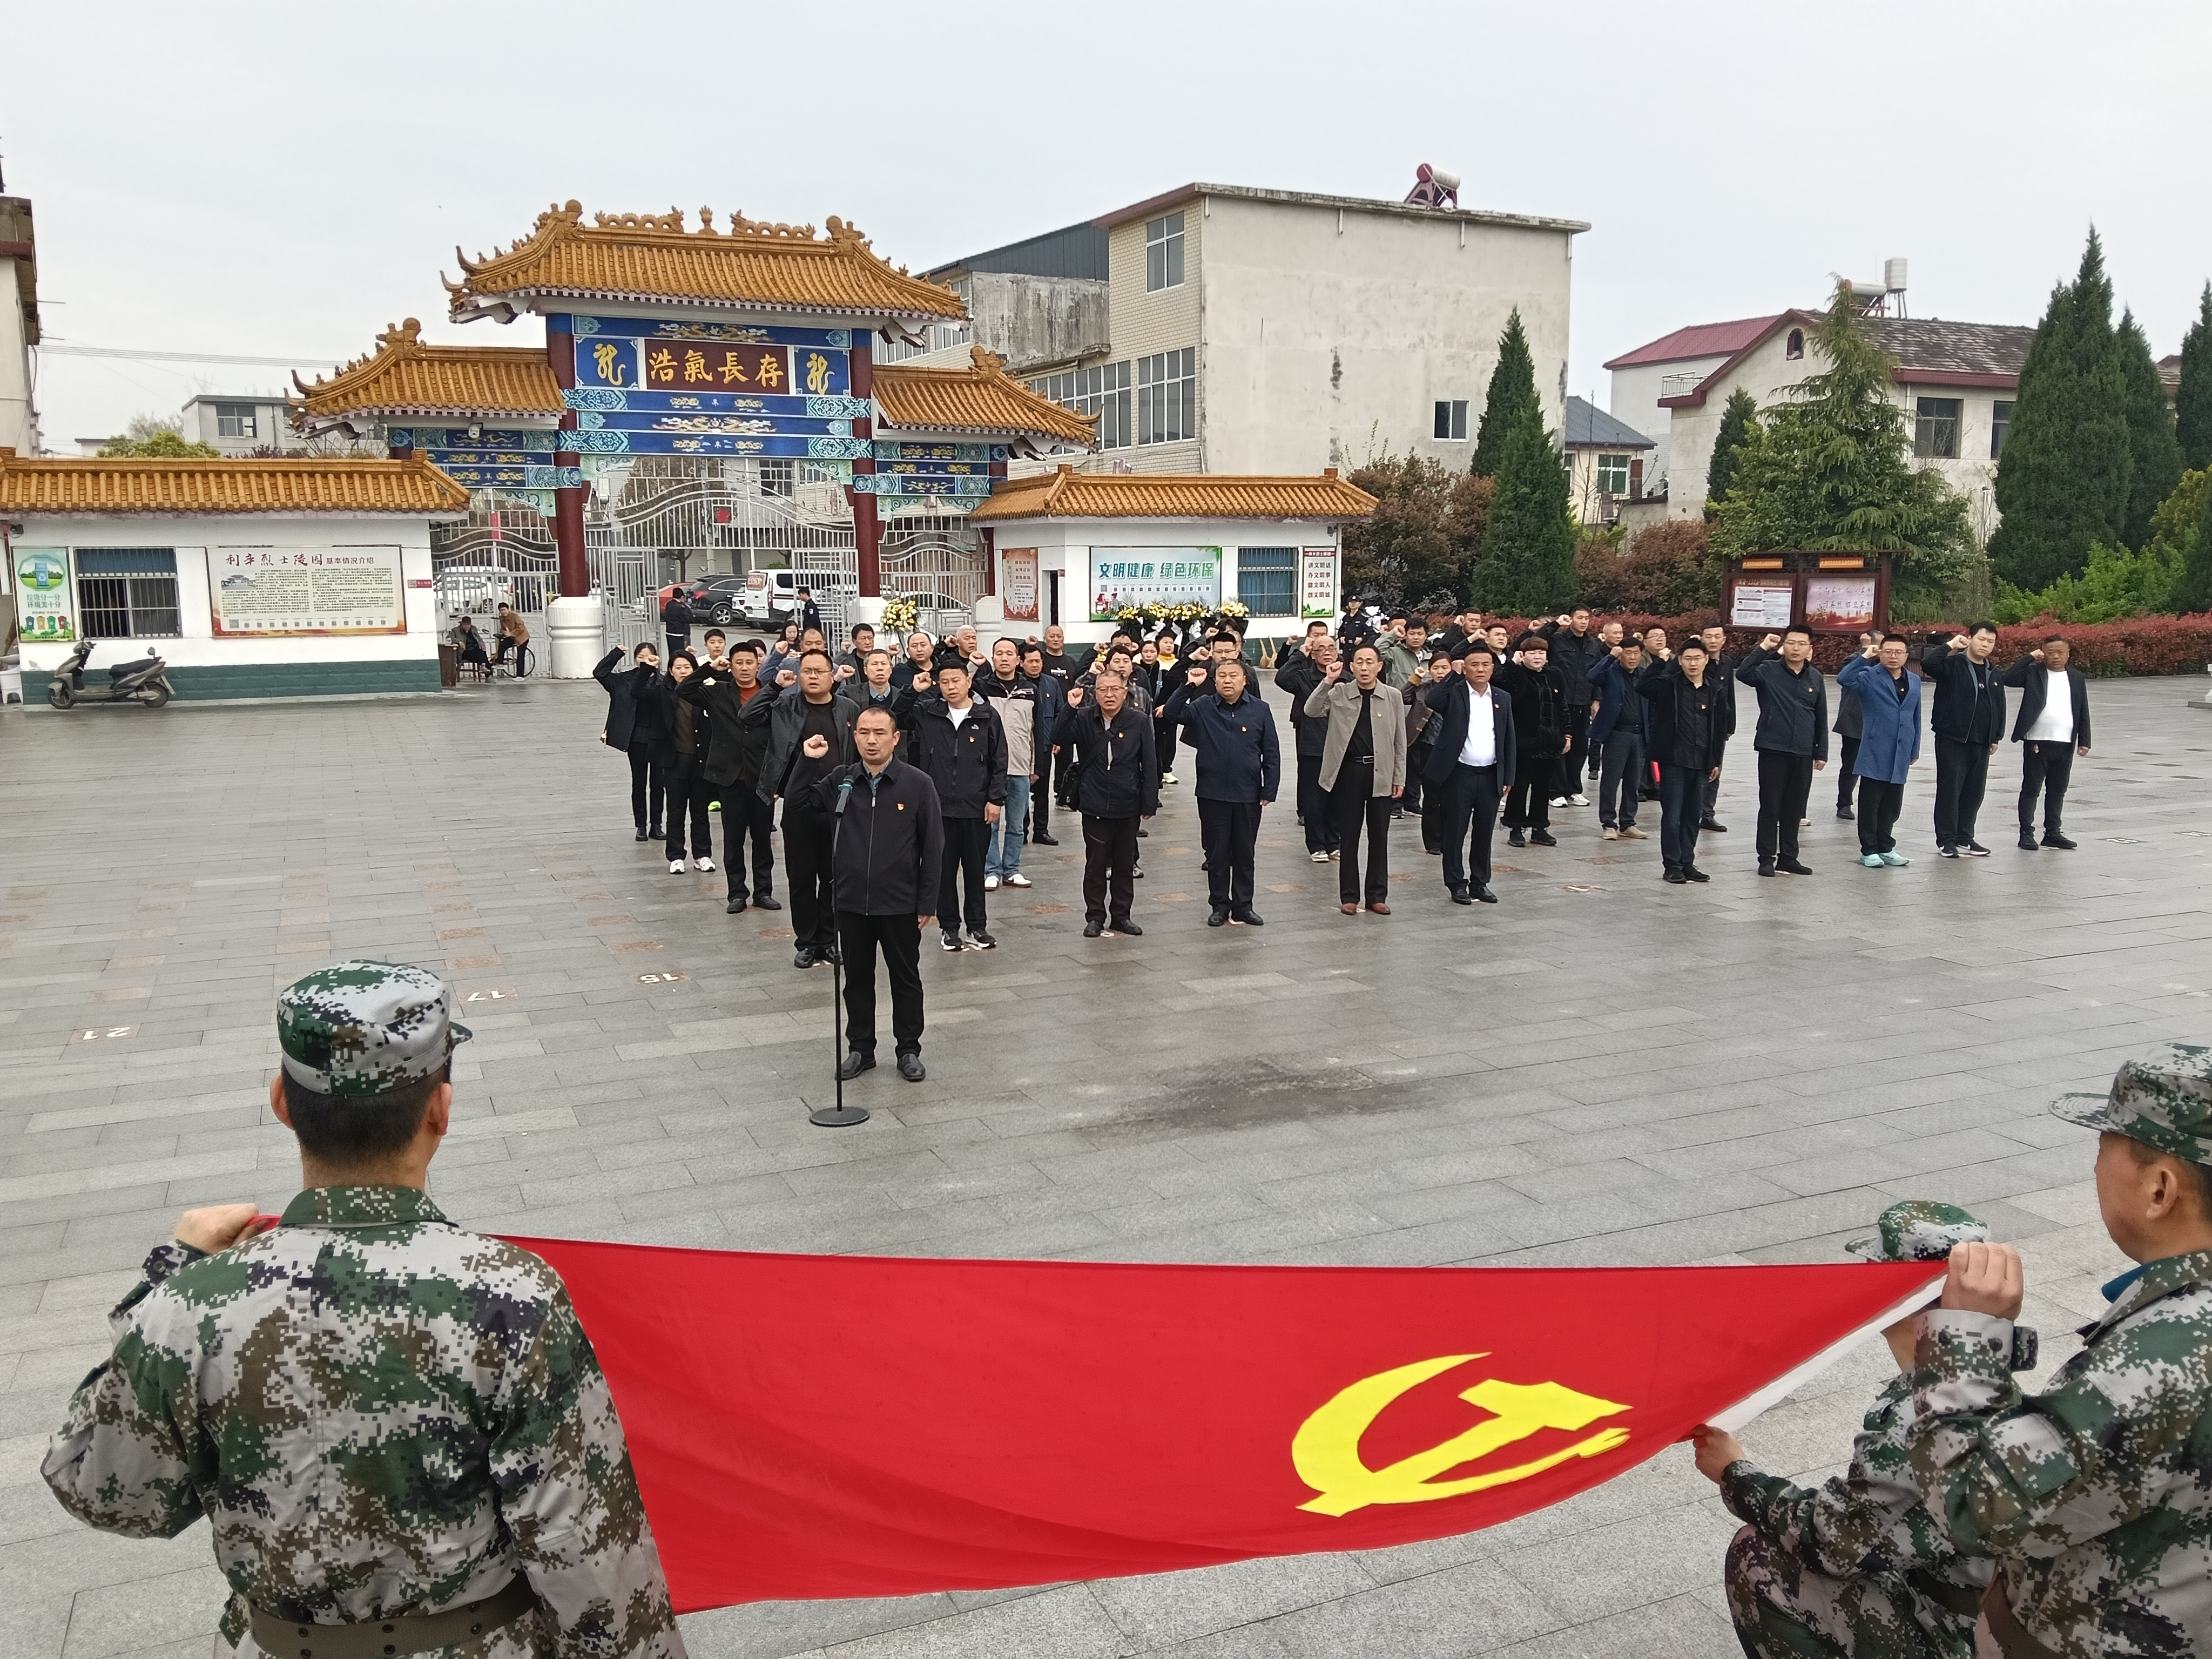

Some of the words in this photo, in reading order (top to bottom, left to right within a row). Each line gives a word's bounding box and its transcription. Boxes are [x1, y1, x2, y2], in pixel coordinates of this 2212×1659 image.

[649, 348, 784, 387] 浩氣長存
[1098, 562, 1155, 579] 文明健康
[1160, 562, 1214, 579] 绿色环保
[640, 973, 679, 983] 15
[468, 990, 505, 1002] 17
[83, 1027, 131, 1040] 21
